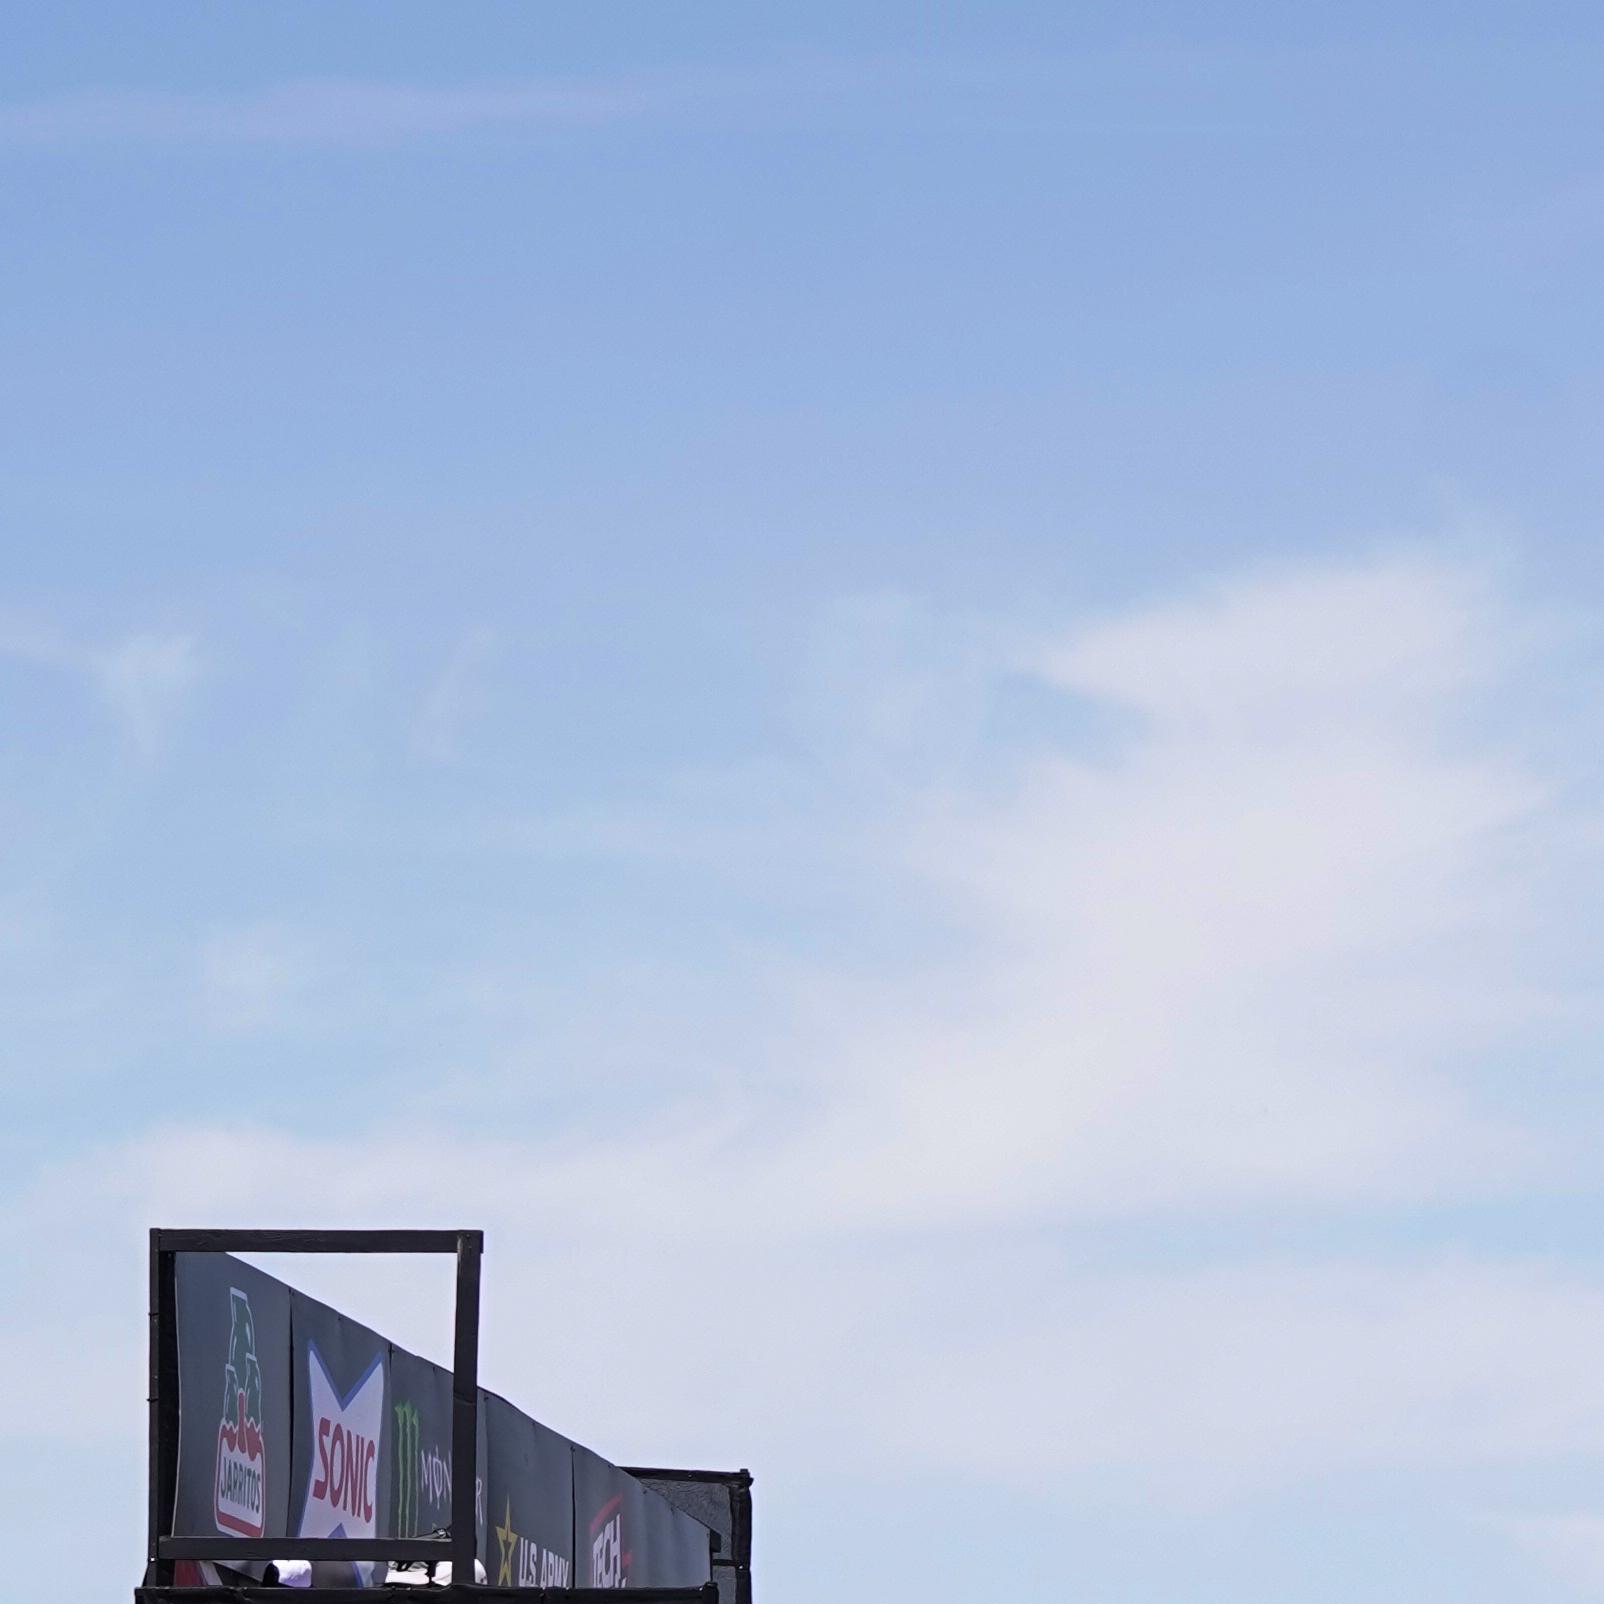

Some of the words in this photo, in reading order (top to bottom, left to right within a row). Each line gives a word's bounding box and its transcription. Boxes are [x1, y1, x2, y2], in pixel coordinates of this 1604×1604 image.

[220, 1456, 261, 1515] JARRITOS
[312, 1416, 376, 1524] SONIC
[540, 1548, 570, 1589] ARMY
